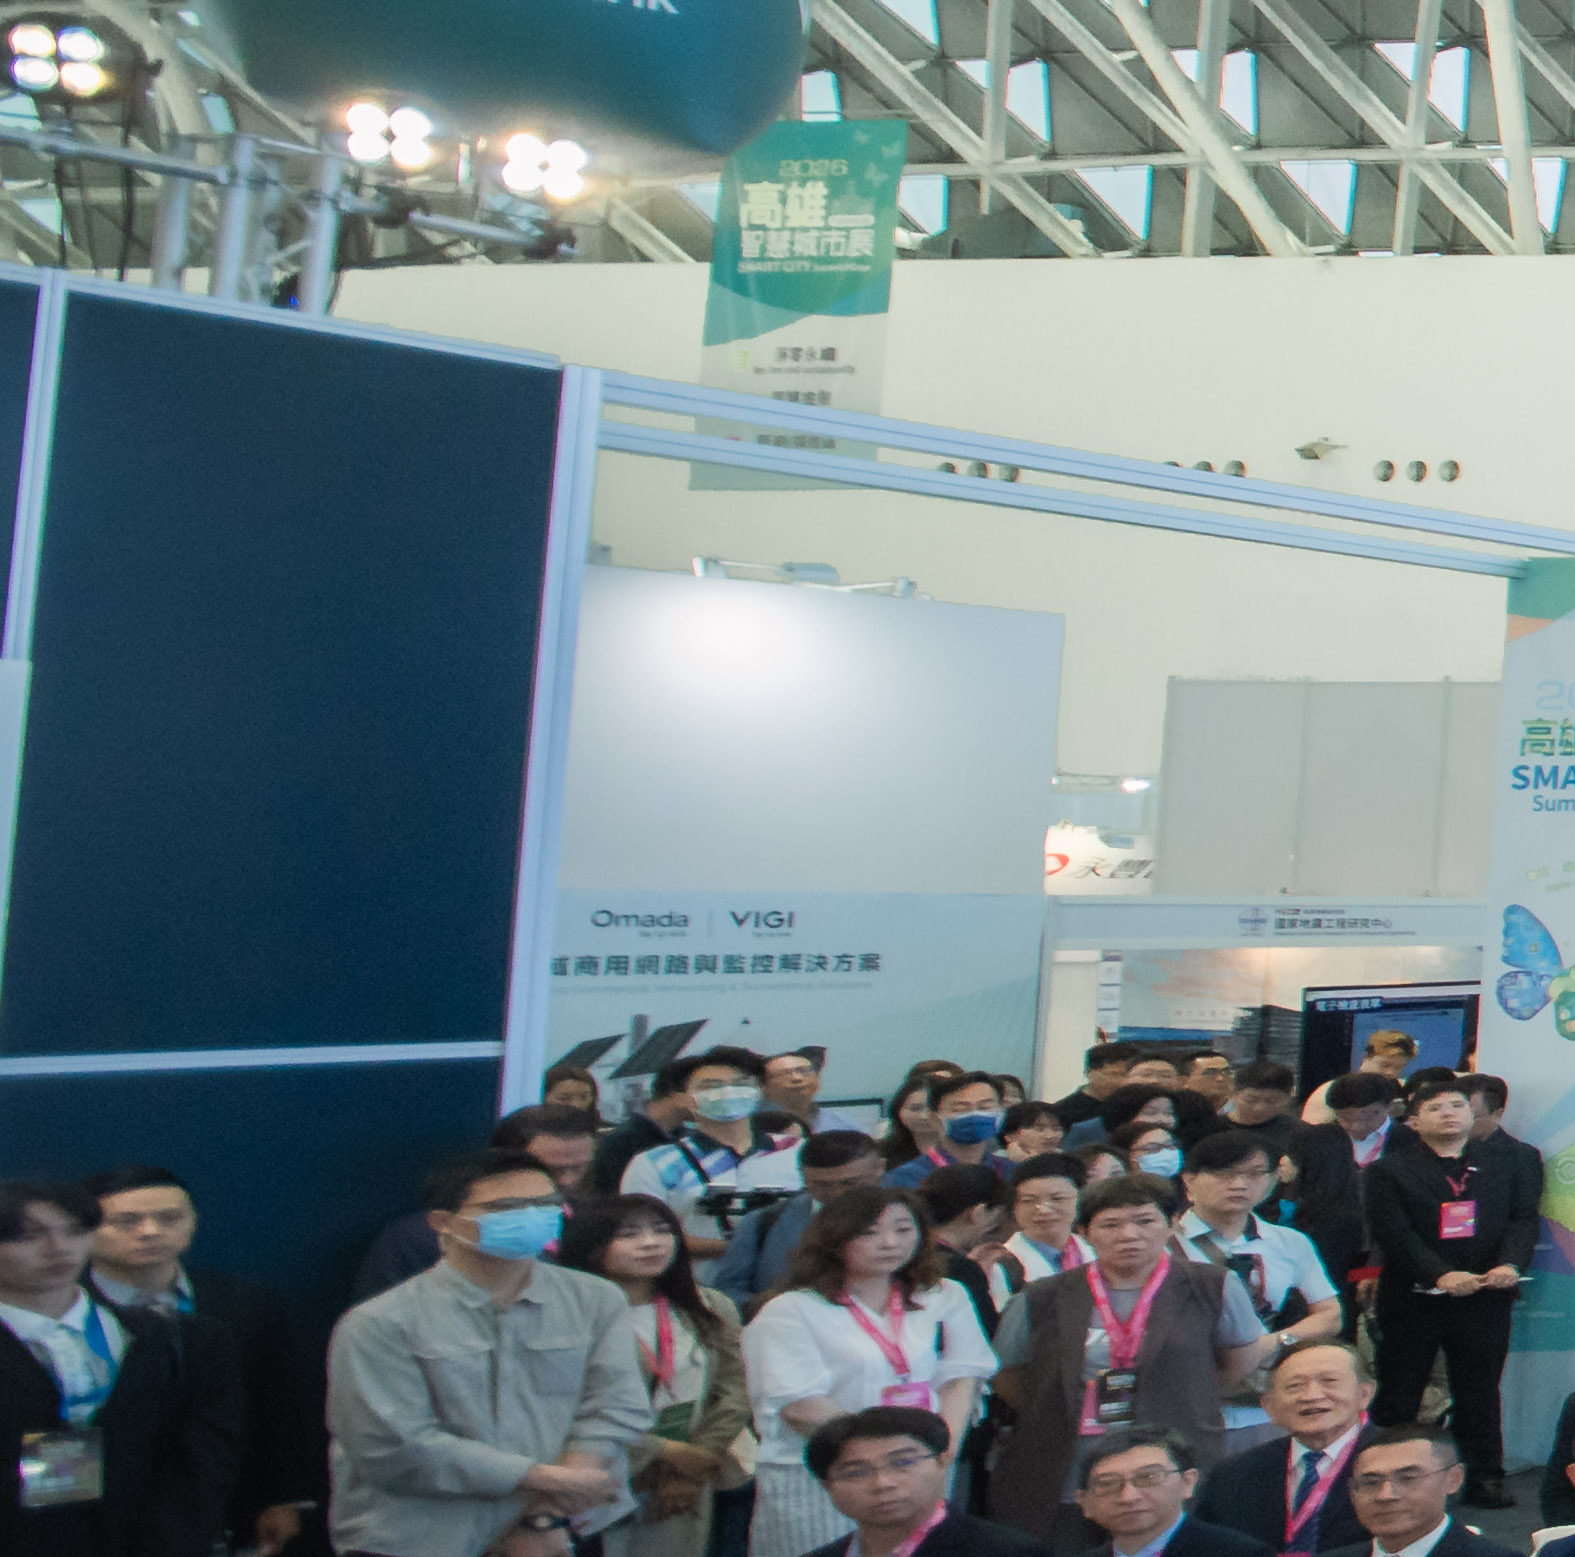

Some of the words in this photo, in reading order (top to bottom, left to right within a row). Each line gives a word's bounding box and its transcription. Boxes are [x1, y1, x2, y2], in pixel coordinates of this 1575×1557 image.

[779, 159, 848, 177] 2026
[739, 181, 829, 228] 高雄
[741, 229, 875, 258] 智慧城市展
[591, 909, 690, 928] Omada
[729, 910, 796, 928] VIGI
